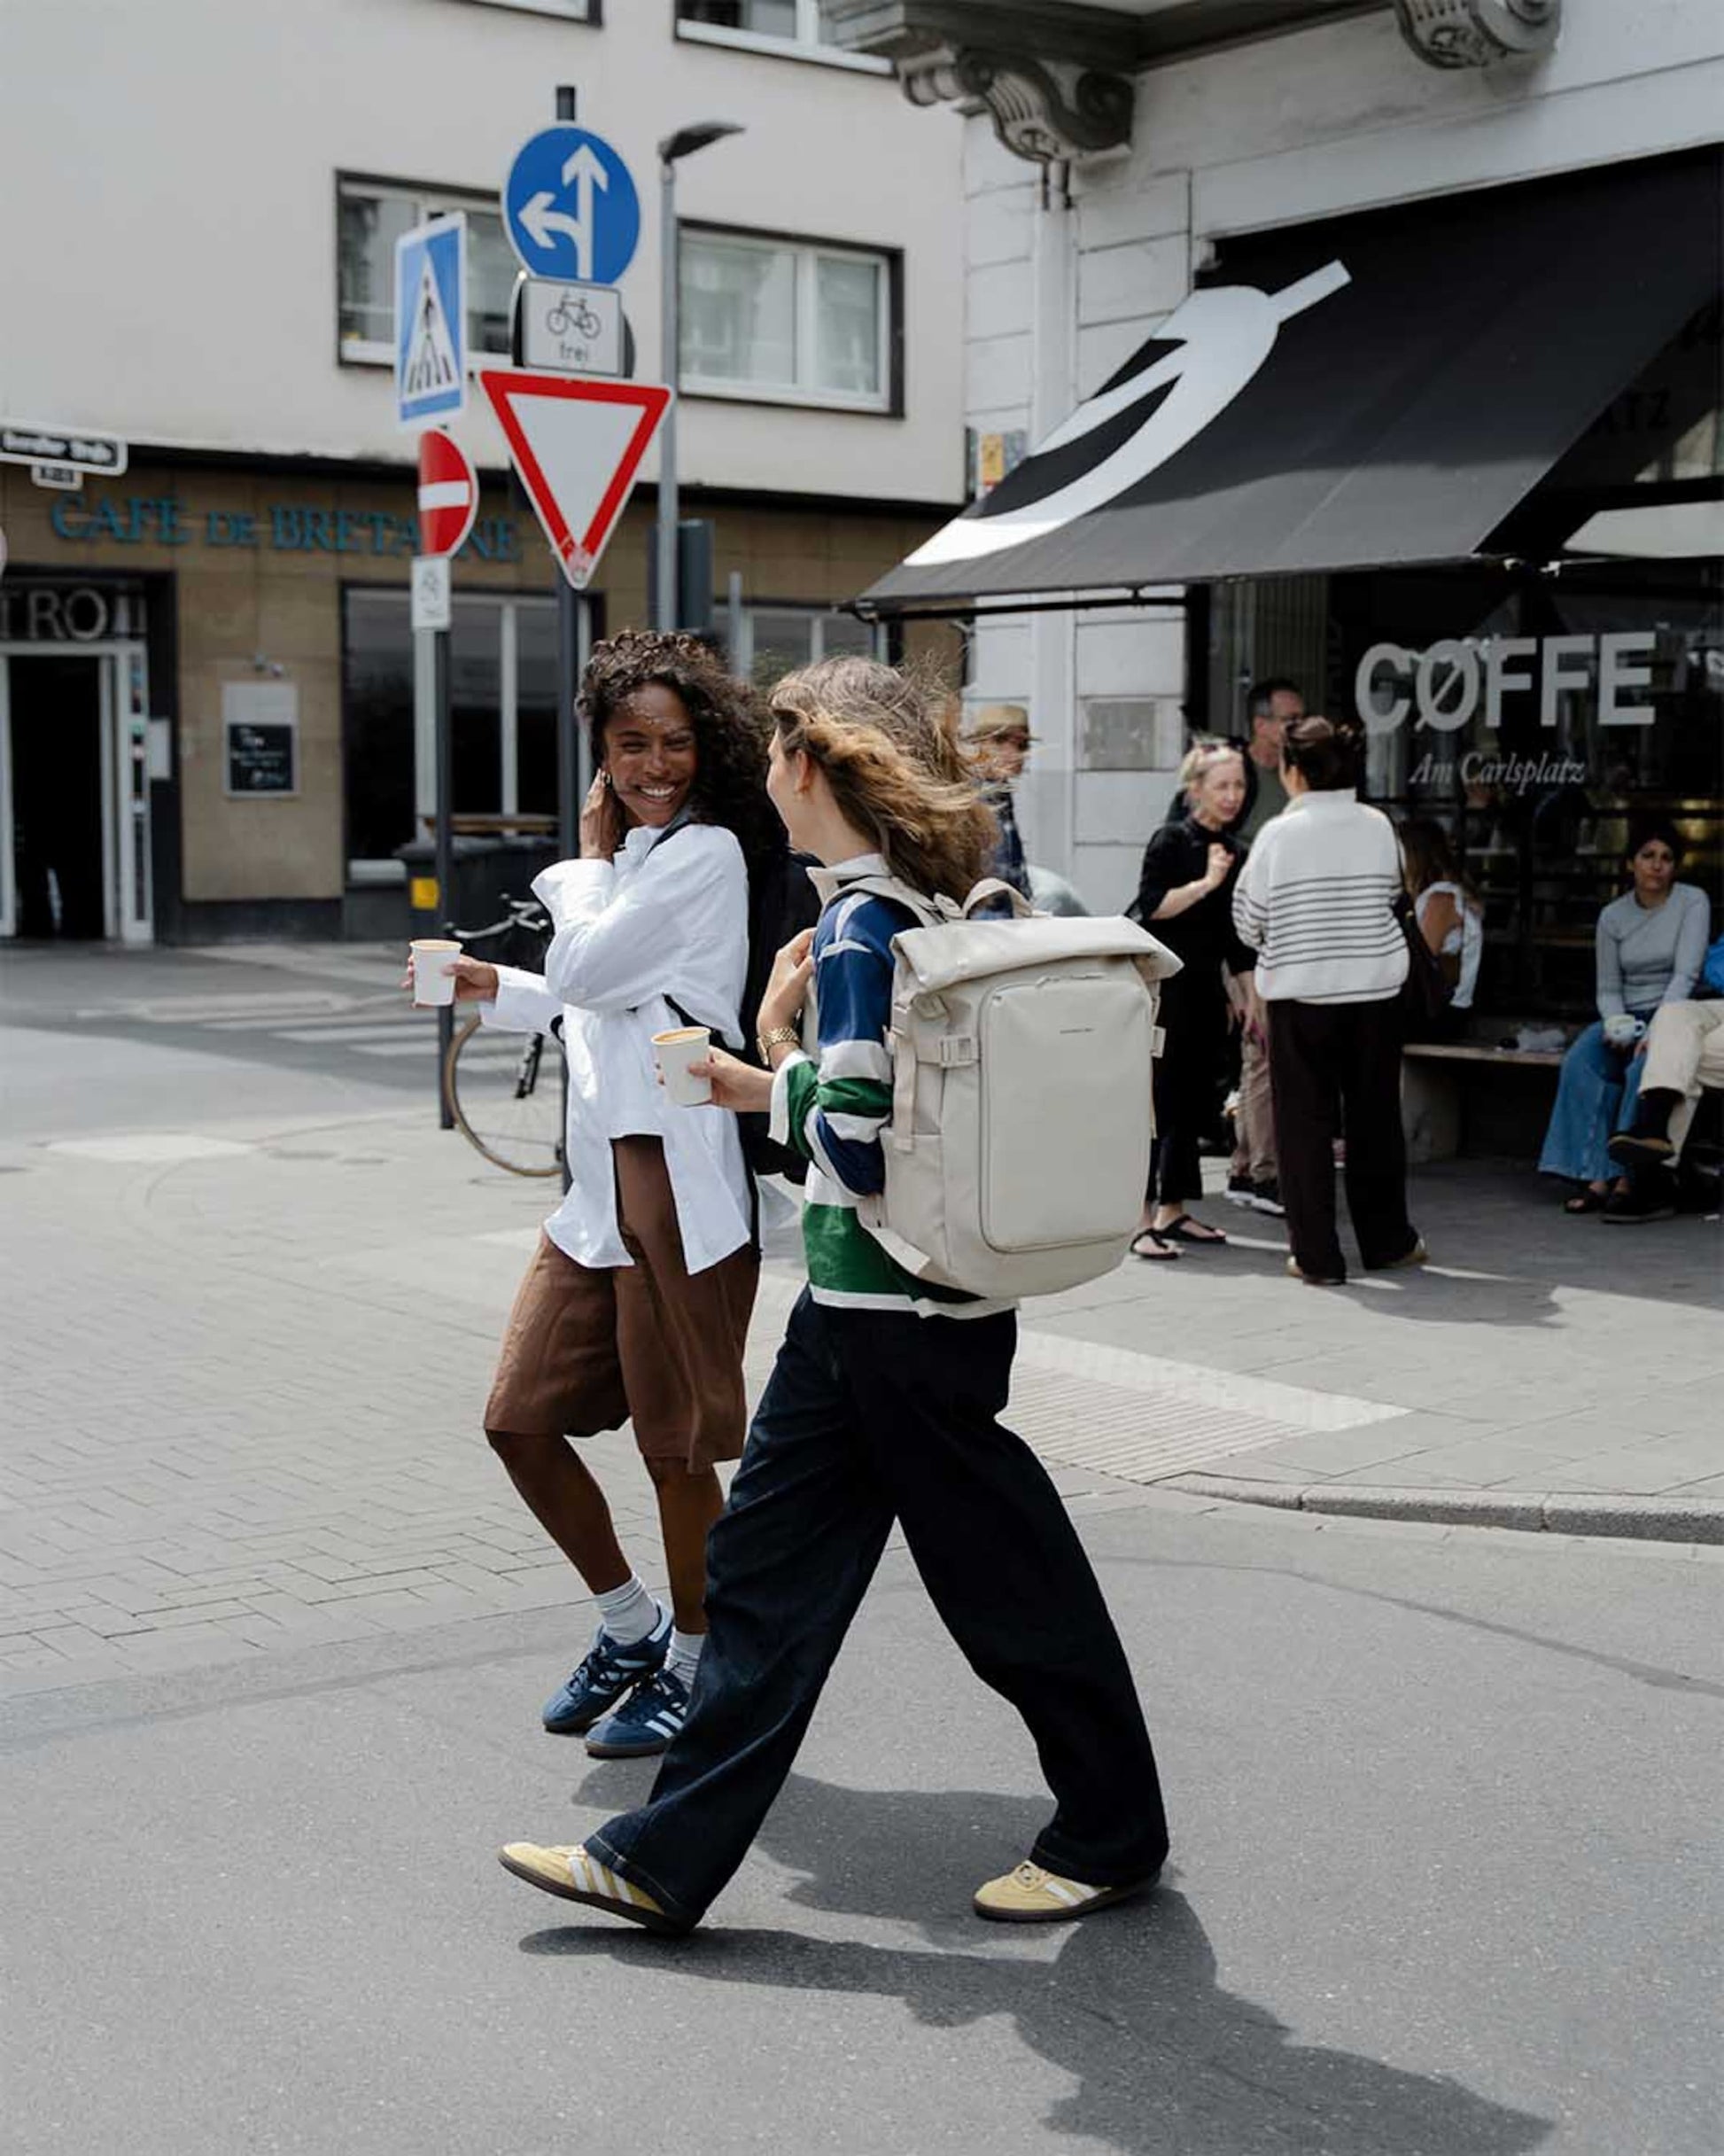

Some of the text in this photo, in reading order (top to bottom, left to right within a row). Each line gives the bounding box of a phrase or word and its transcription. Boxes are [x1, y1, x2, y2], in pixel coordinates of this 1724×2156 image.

[268, 503, 523, 563] BRETANE
[1355, 632, 1656, 732] CØFFE
[1409, 751, 1585, 796] Am Carlsplatz
